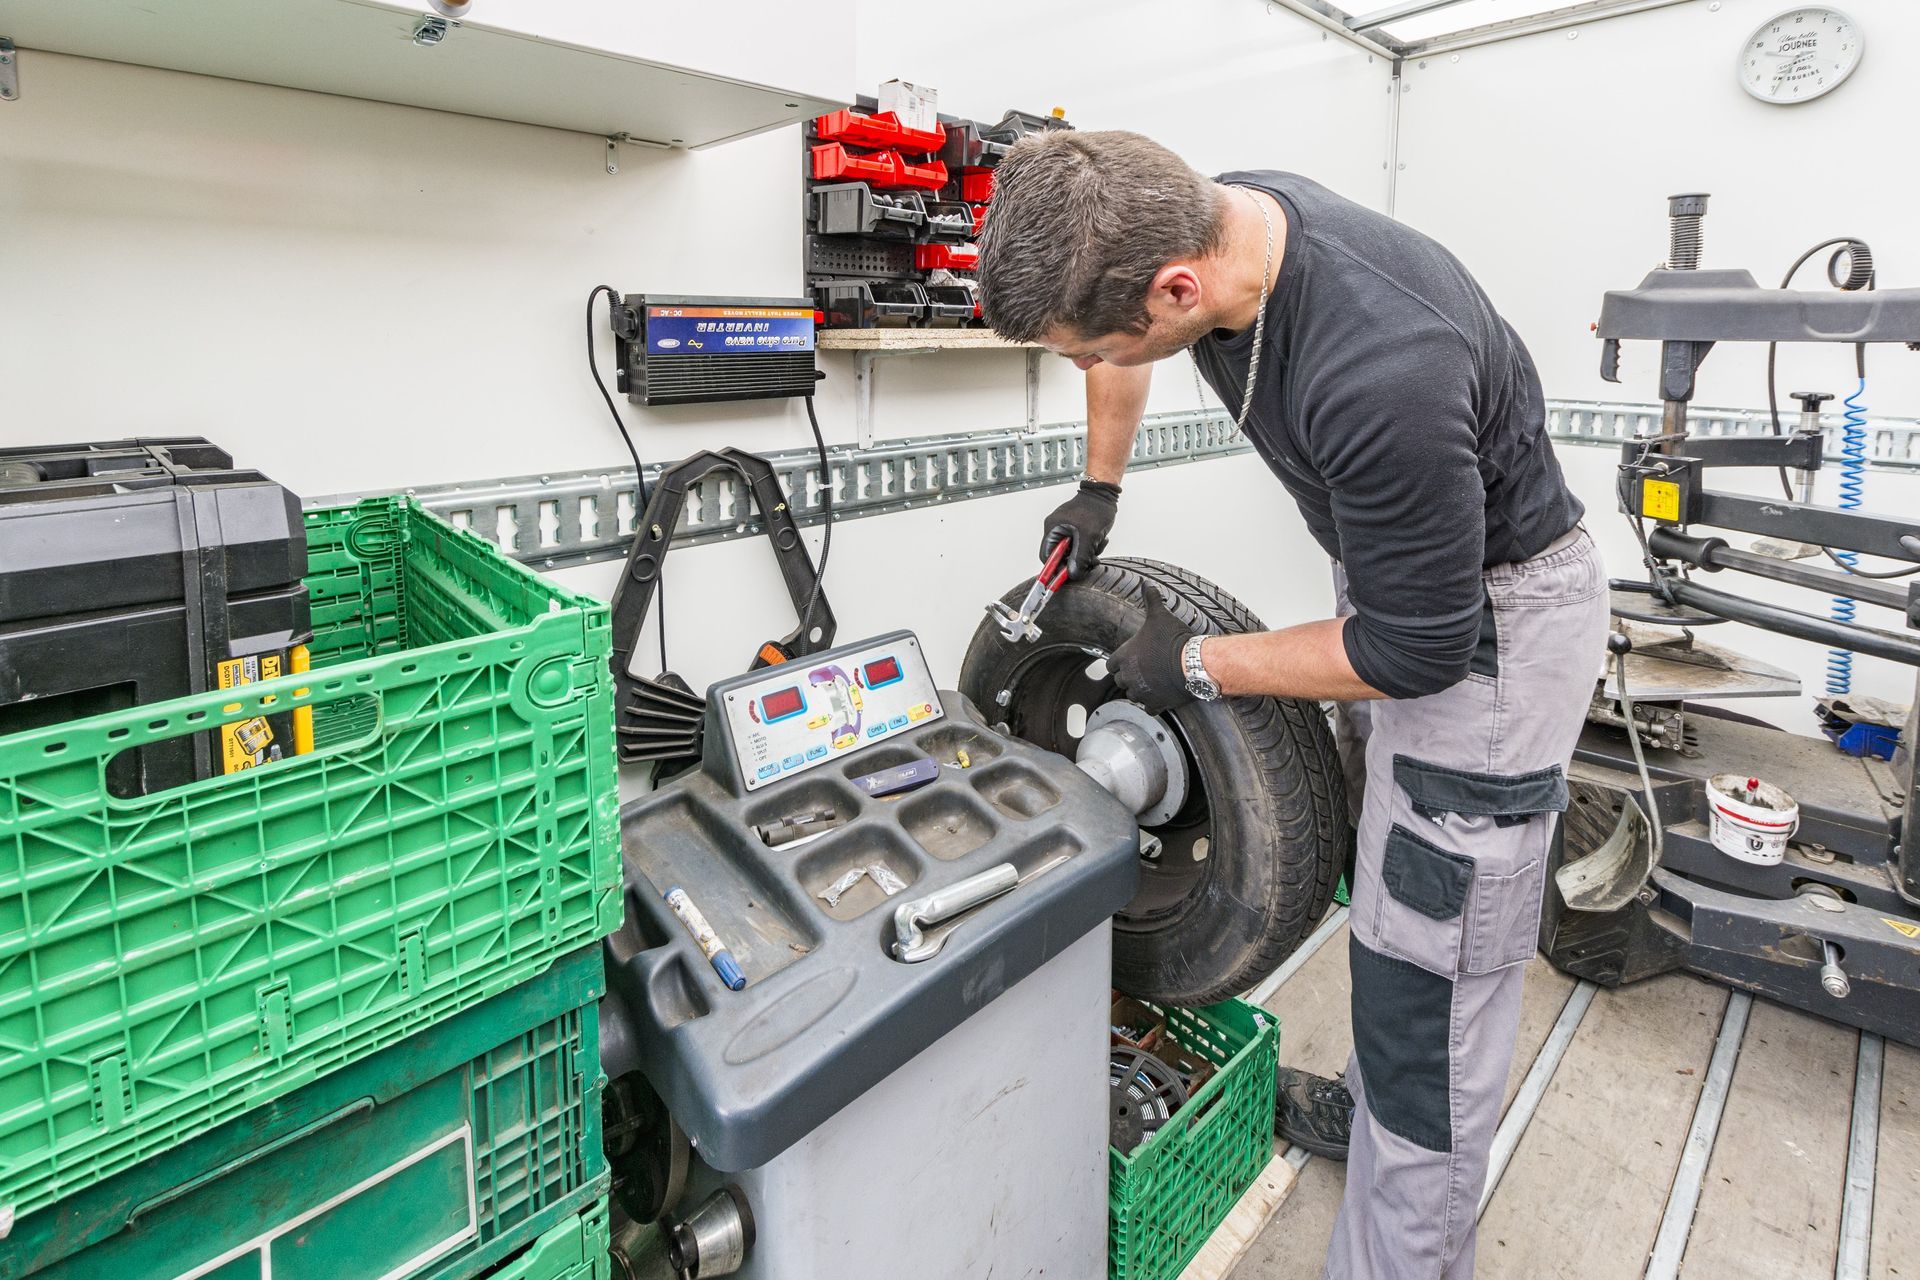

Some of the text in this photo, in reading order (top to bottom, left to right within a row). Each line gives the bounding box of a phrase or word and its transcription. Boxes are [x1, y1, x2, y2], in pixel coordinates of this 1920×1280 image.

[696, 322, 770, 332] INVERTER
[725, 336, 807, 348] Pure sine wave
[810, 746, 822, 756] FUNC
[758, 764, 774, 773] MODE
